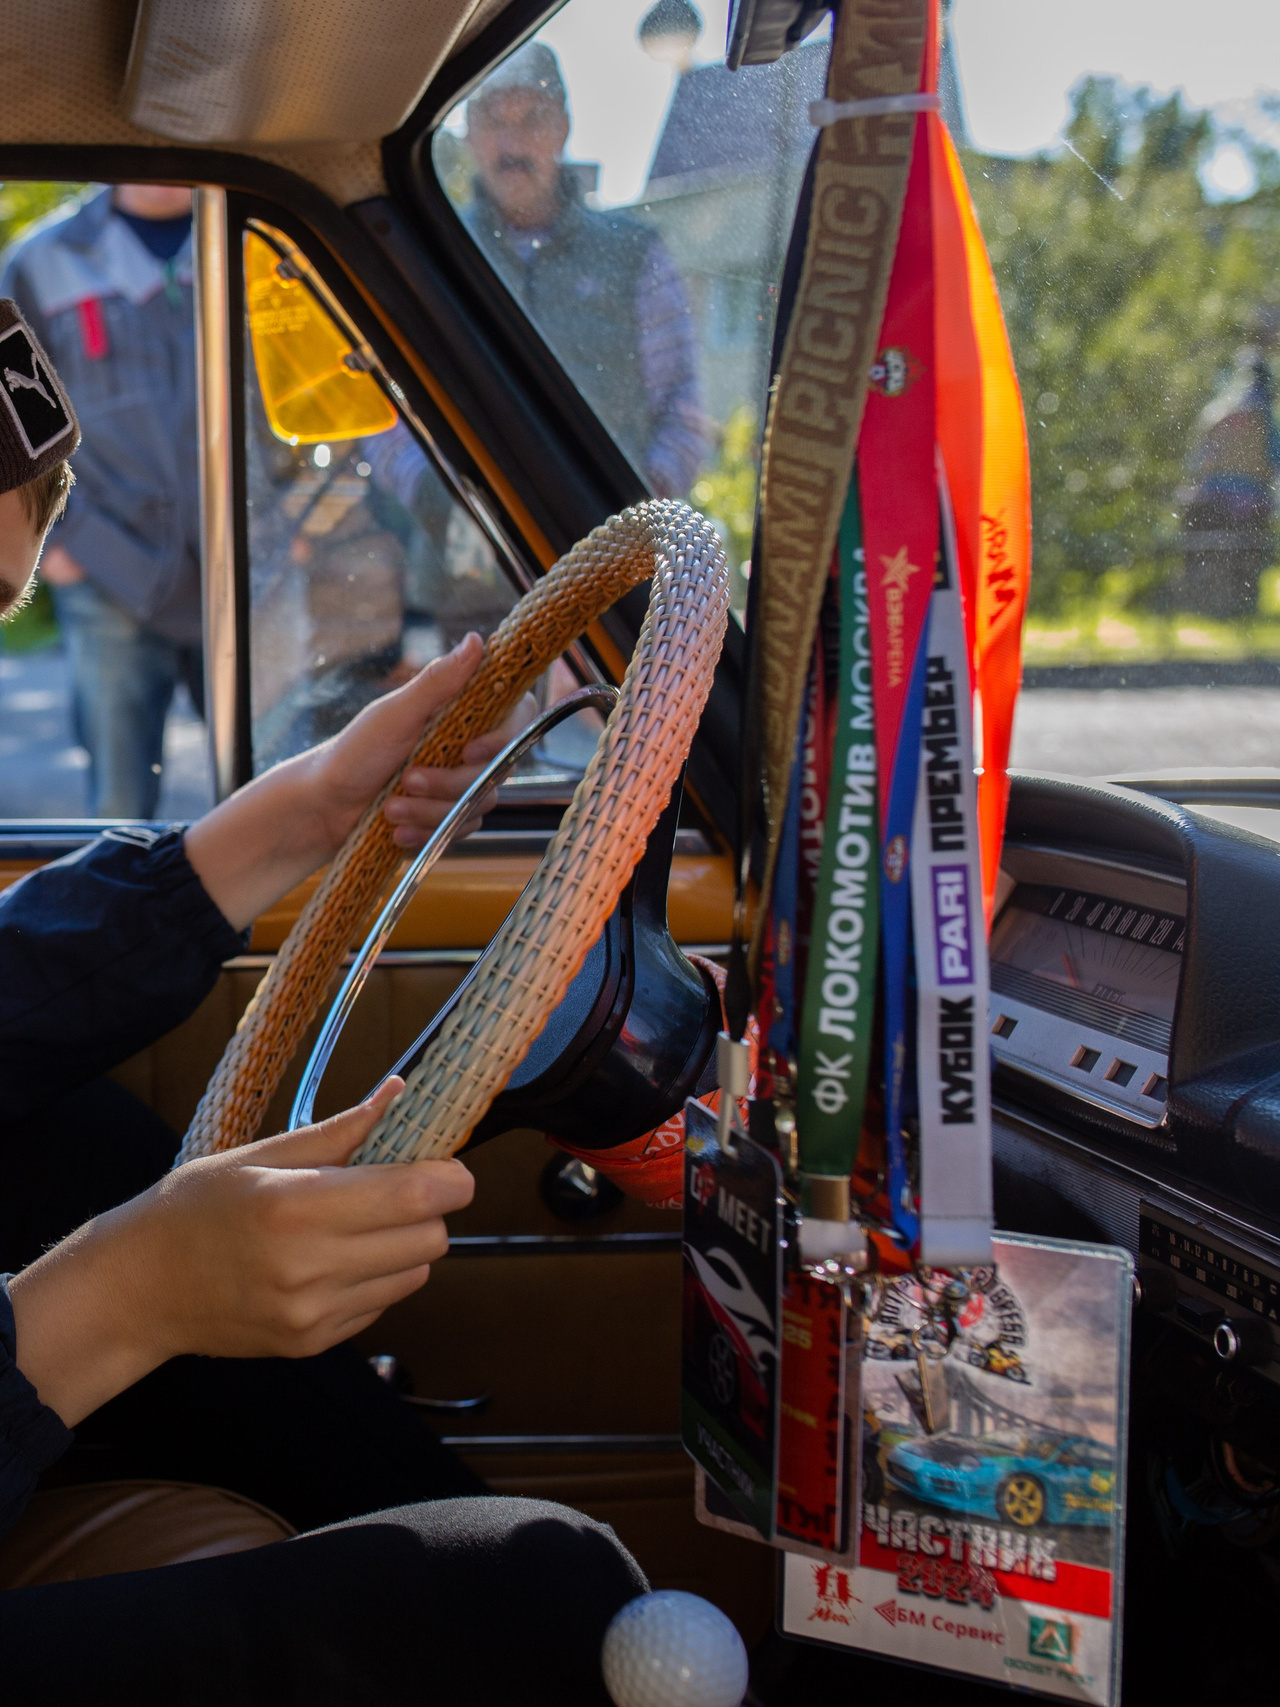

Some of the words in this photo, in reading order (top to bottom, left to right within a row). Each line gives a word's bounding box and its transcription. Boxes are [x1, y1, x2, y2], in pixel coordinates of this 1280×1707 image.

[783, 183, 878, 432] PICNIC
[924, 656, 966, 851] ПРЕМЬЕР
[819, 744, 878, 1041] ЛОКОМОТИВ
[934, 870, 970, 980] PARI
[1049, 892, 1066, 916] 0
[1065, 896, 1086, 922] 20
[1086, 902, 1105, 927] 40
[1100, 905, 1122, 931] 60
[1115, 909, 1137, 935] 80
[1130, 914, 1155, 940] 100
[1149, 919, 1174, 945] 120
[811, 1050, 854, 1114] ФК
[939, 996, 975, 1125] КУБОК
[718, 1185, 771, 1254] MEET
[896, 1554, 995, 1612] 2024
[897, 1607, 926, 1627] БМ
[931, 1613, 1006, 1646] Сервис
